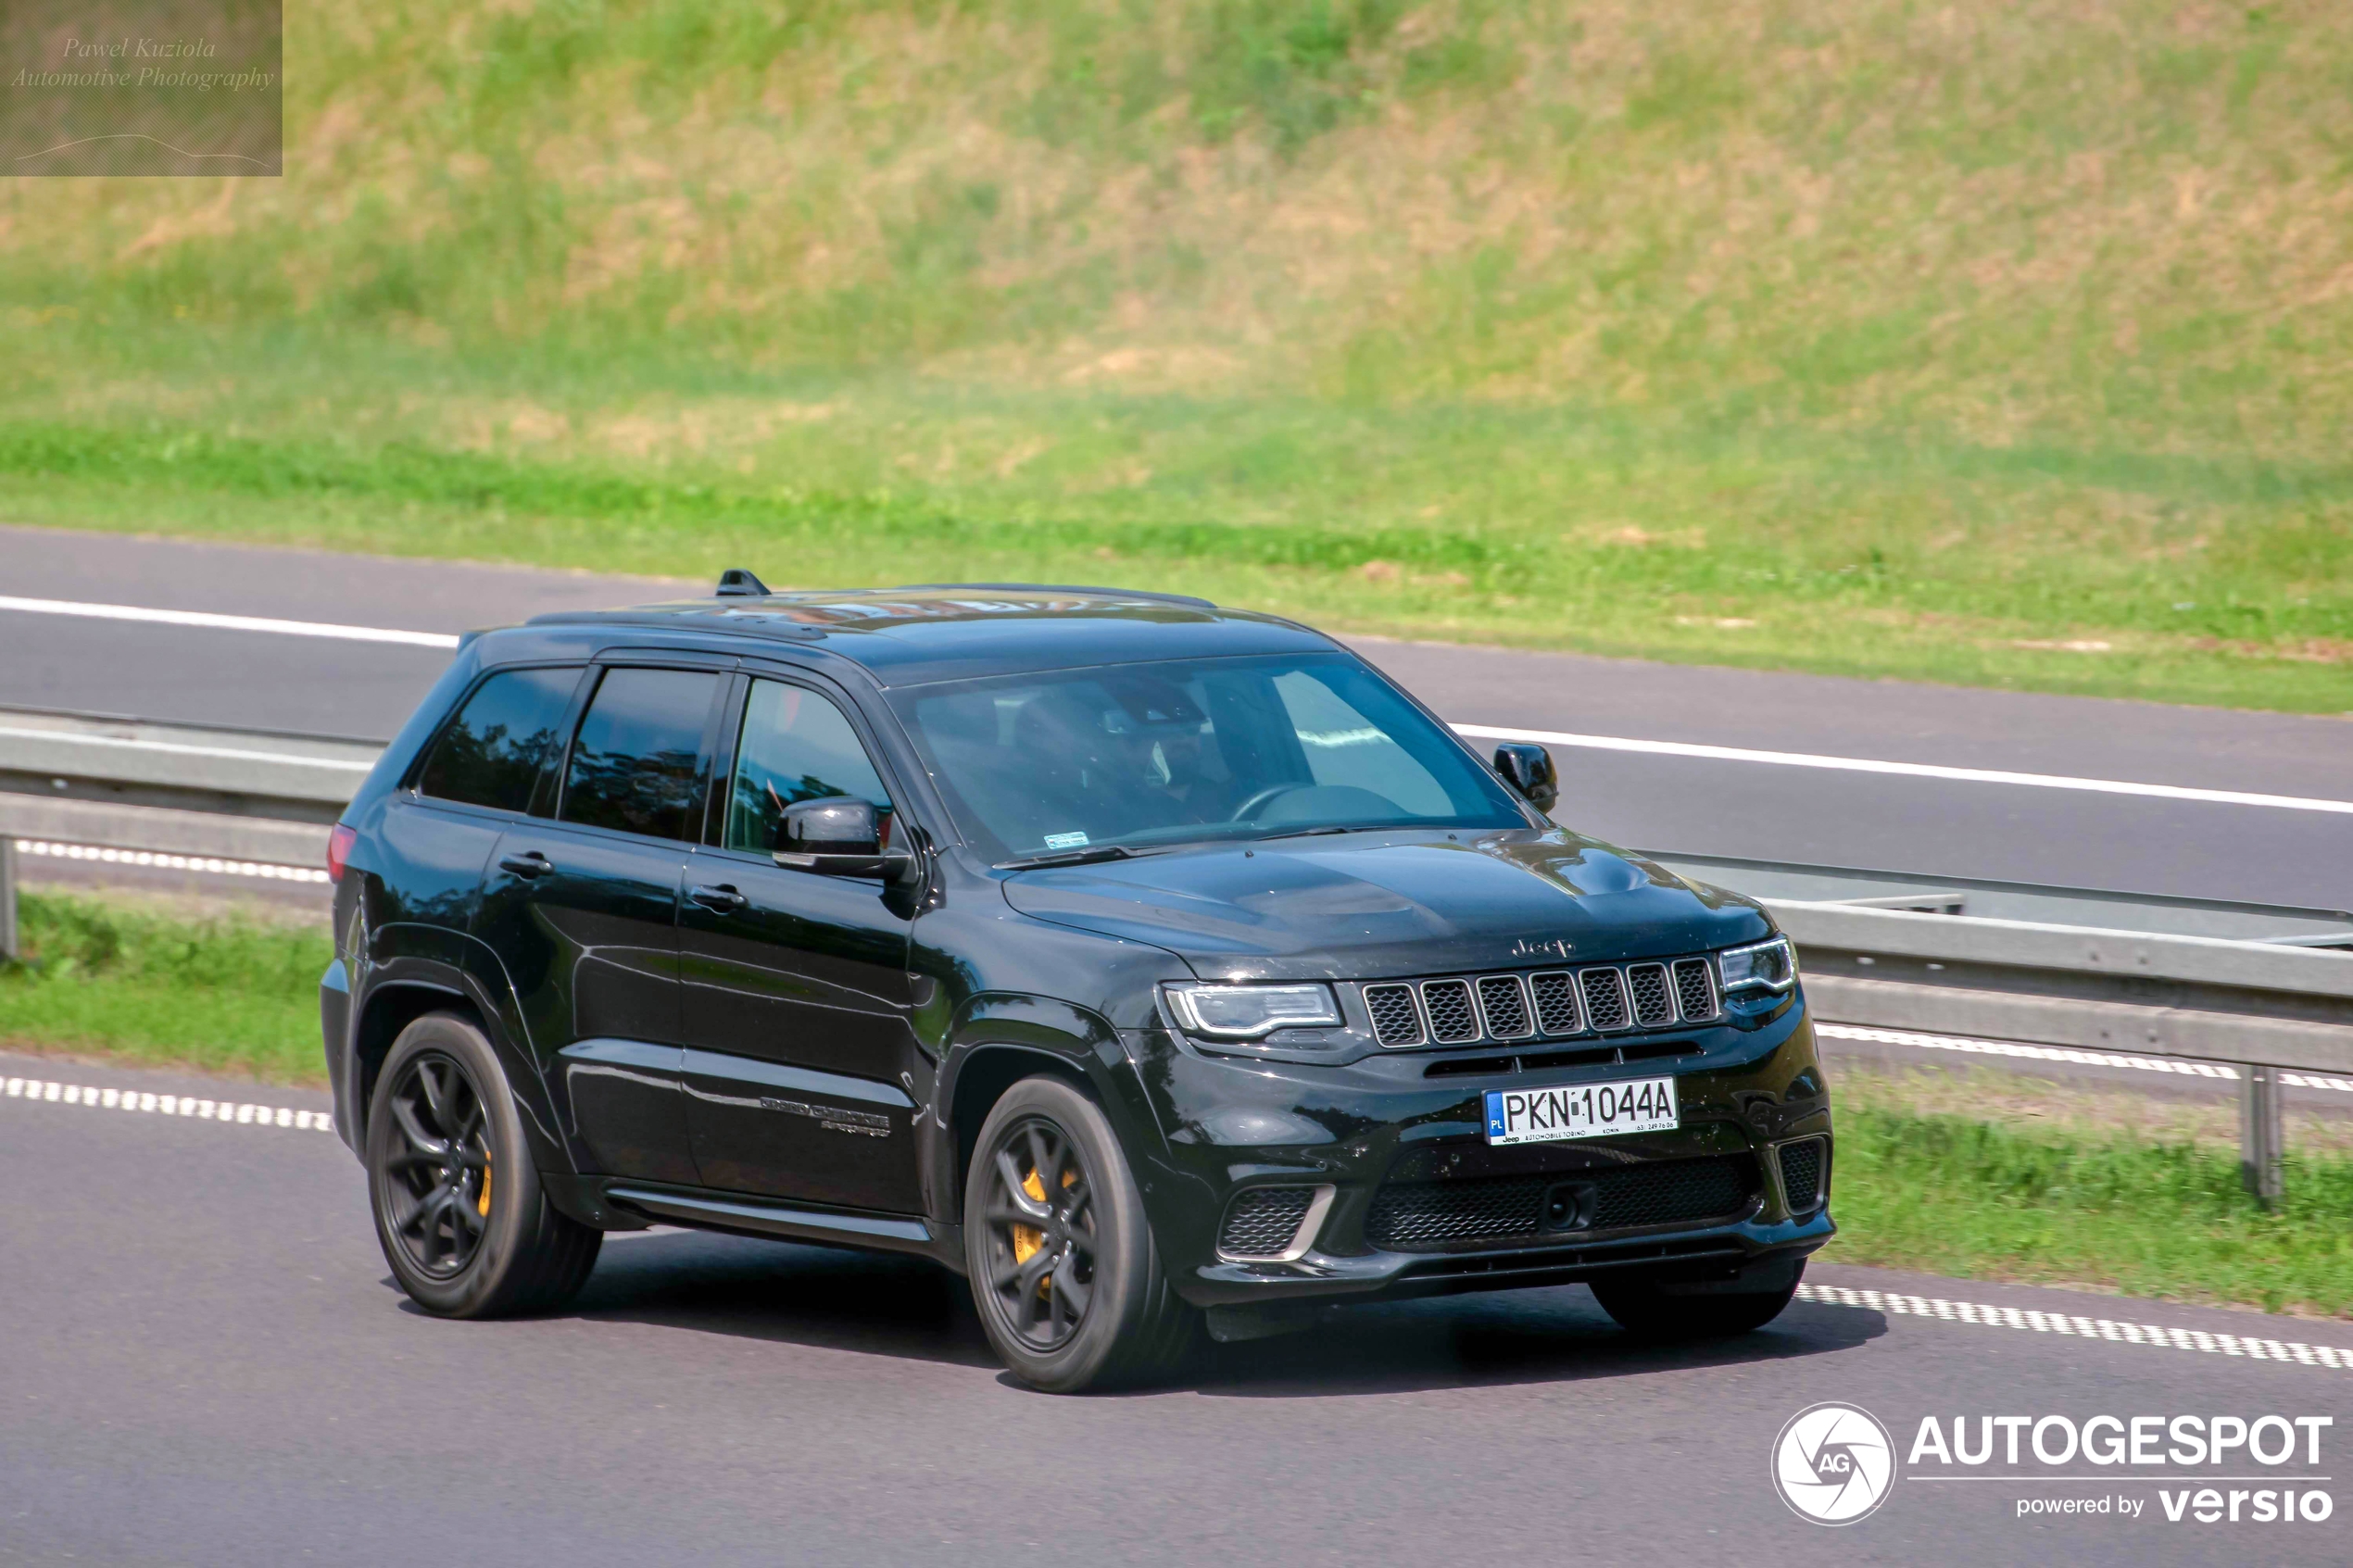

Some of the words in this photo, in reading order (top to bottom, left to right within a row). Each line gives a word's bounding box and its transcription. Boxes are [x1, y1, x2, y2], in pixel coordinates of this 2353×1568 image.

[1512, 938, 1576, 959] Jeep
[1505, 1089, 1570, 1132] PKN
[1581, 1082, 1673, 1124] 1044A
[1491, 1120, 1503, 1130] PL
[1525, 1133, 1561, 1141] AUTOMOBILE
